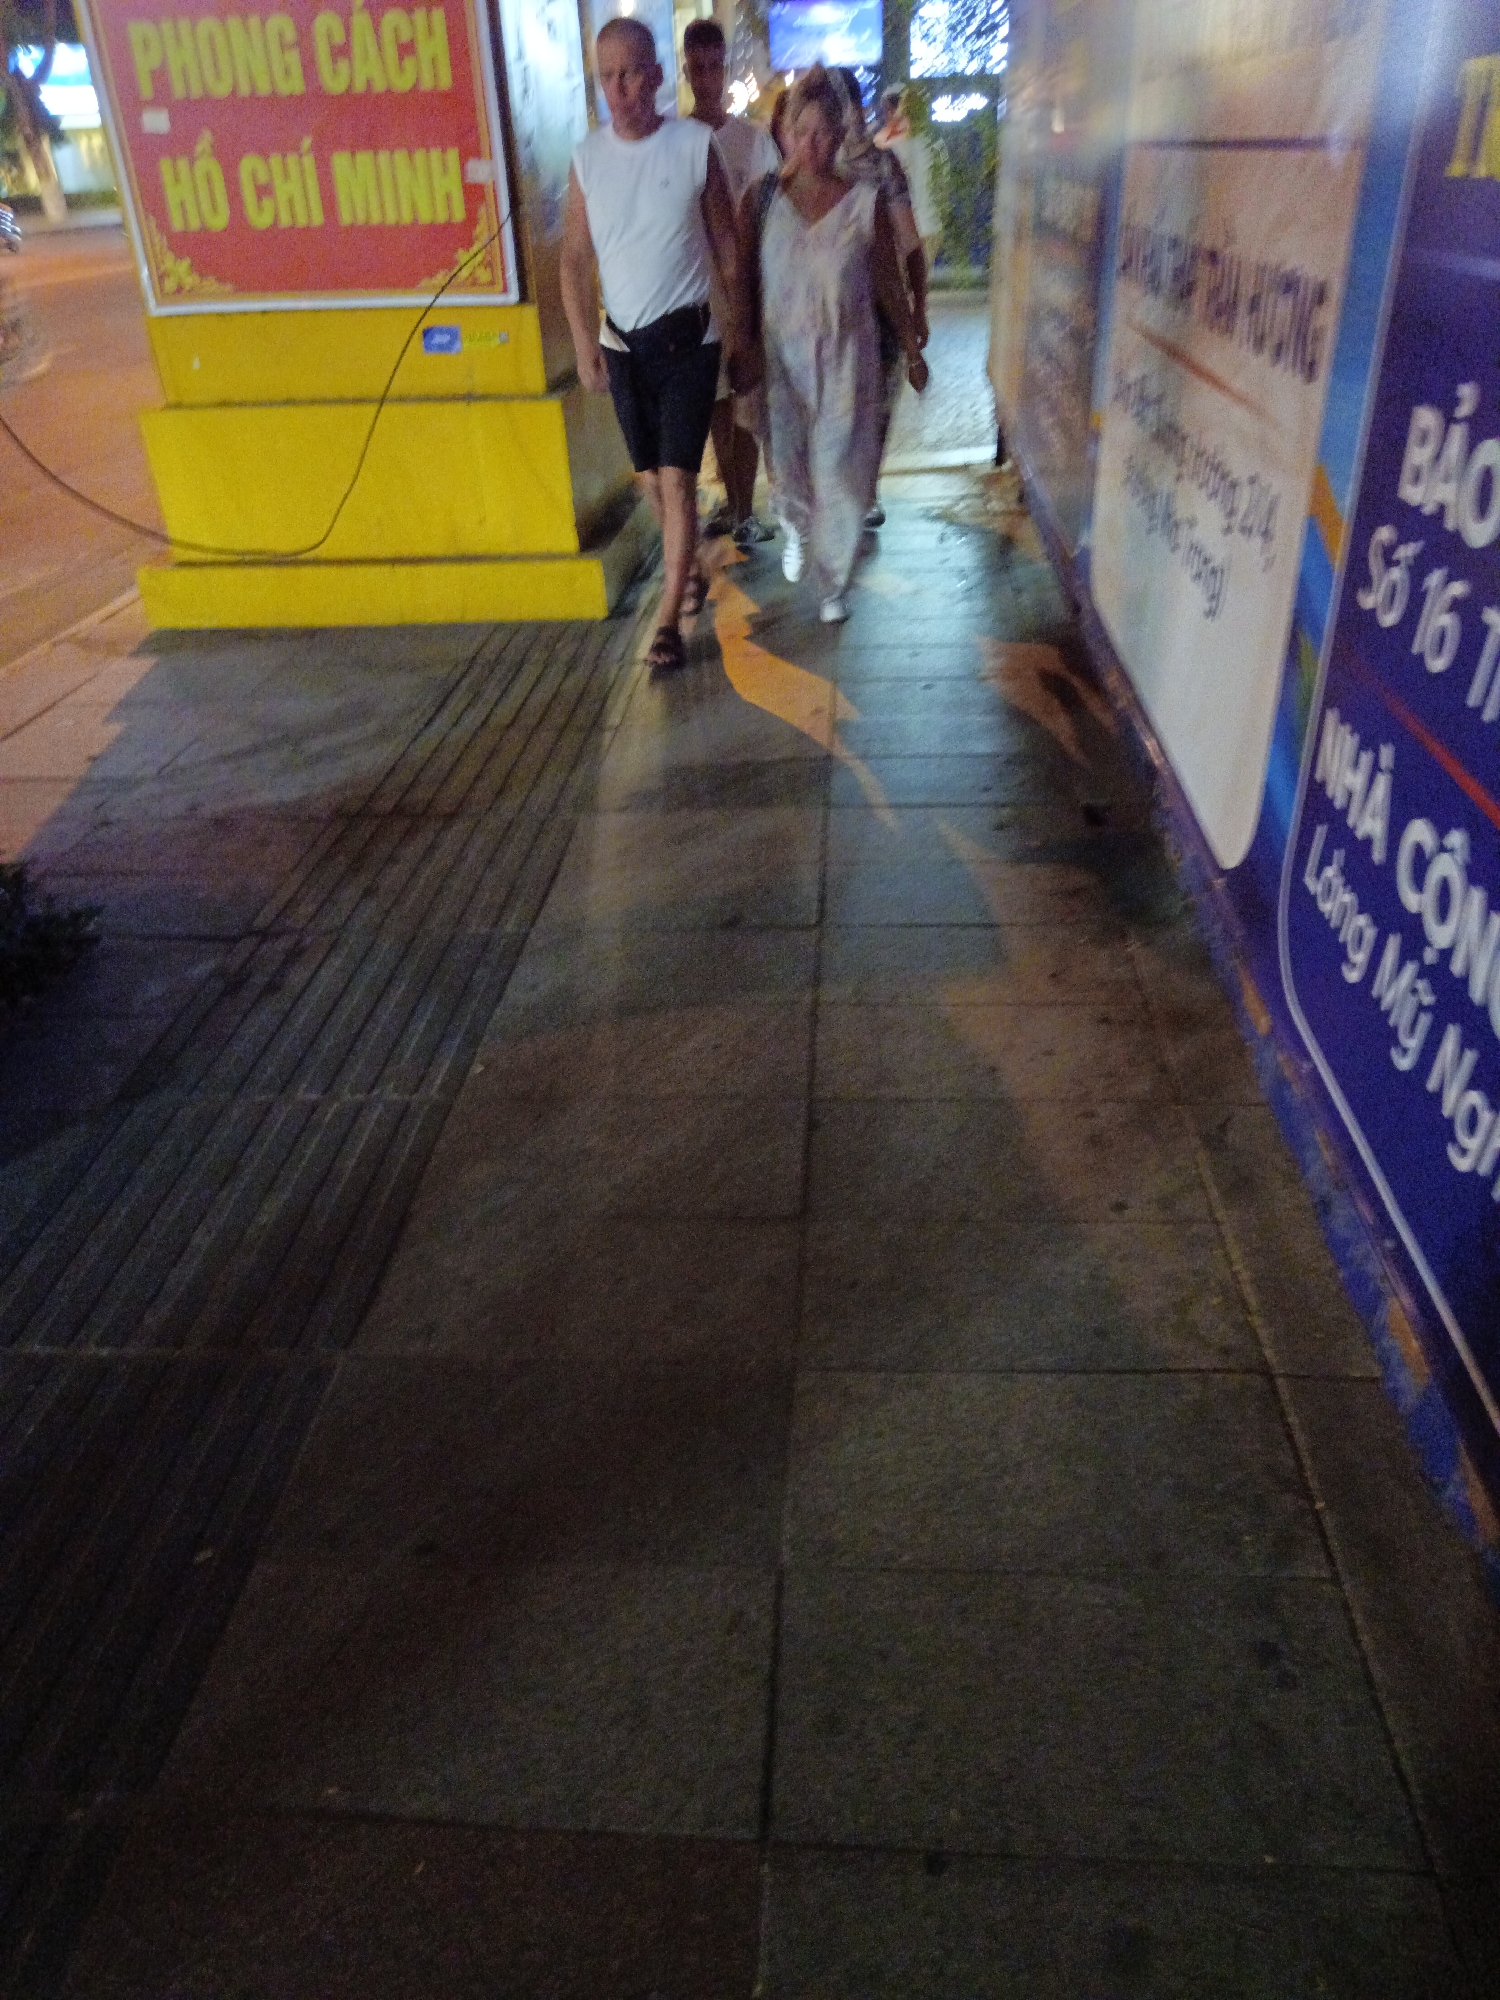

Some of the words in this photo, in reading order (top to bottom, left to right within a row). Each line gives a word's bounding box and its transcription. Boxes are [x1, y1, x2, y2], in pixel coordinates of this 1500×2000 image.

[128, 14, 305, 99] PHONG
[314, 0, 452, 95] CÁCH
[239, 136, 324, 229] CHÍ
[332, 147, 466, 226] MINH
[1357, 524, 1425, 628] Số
[1411, 567, 1471, 674] 16
[1372, 933, 1436, 1072] Mỹ
